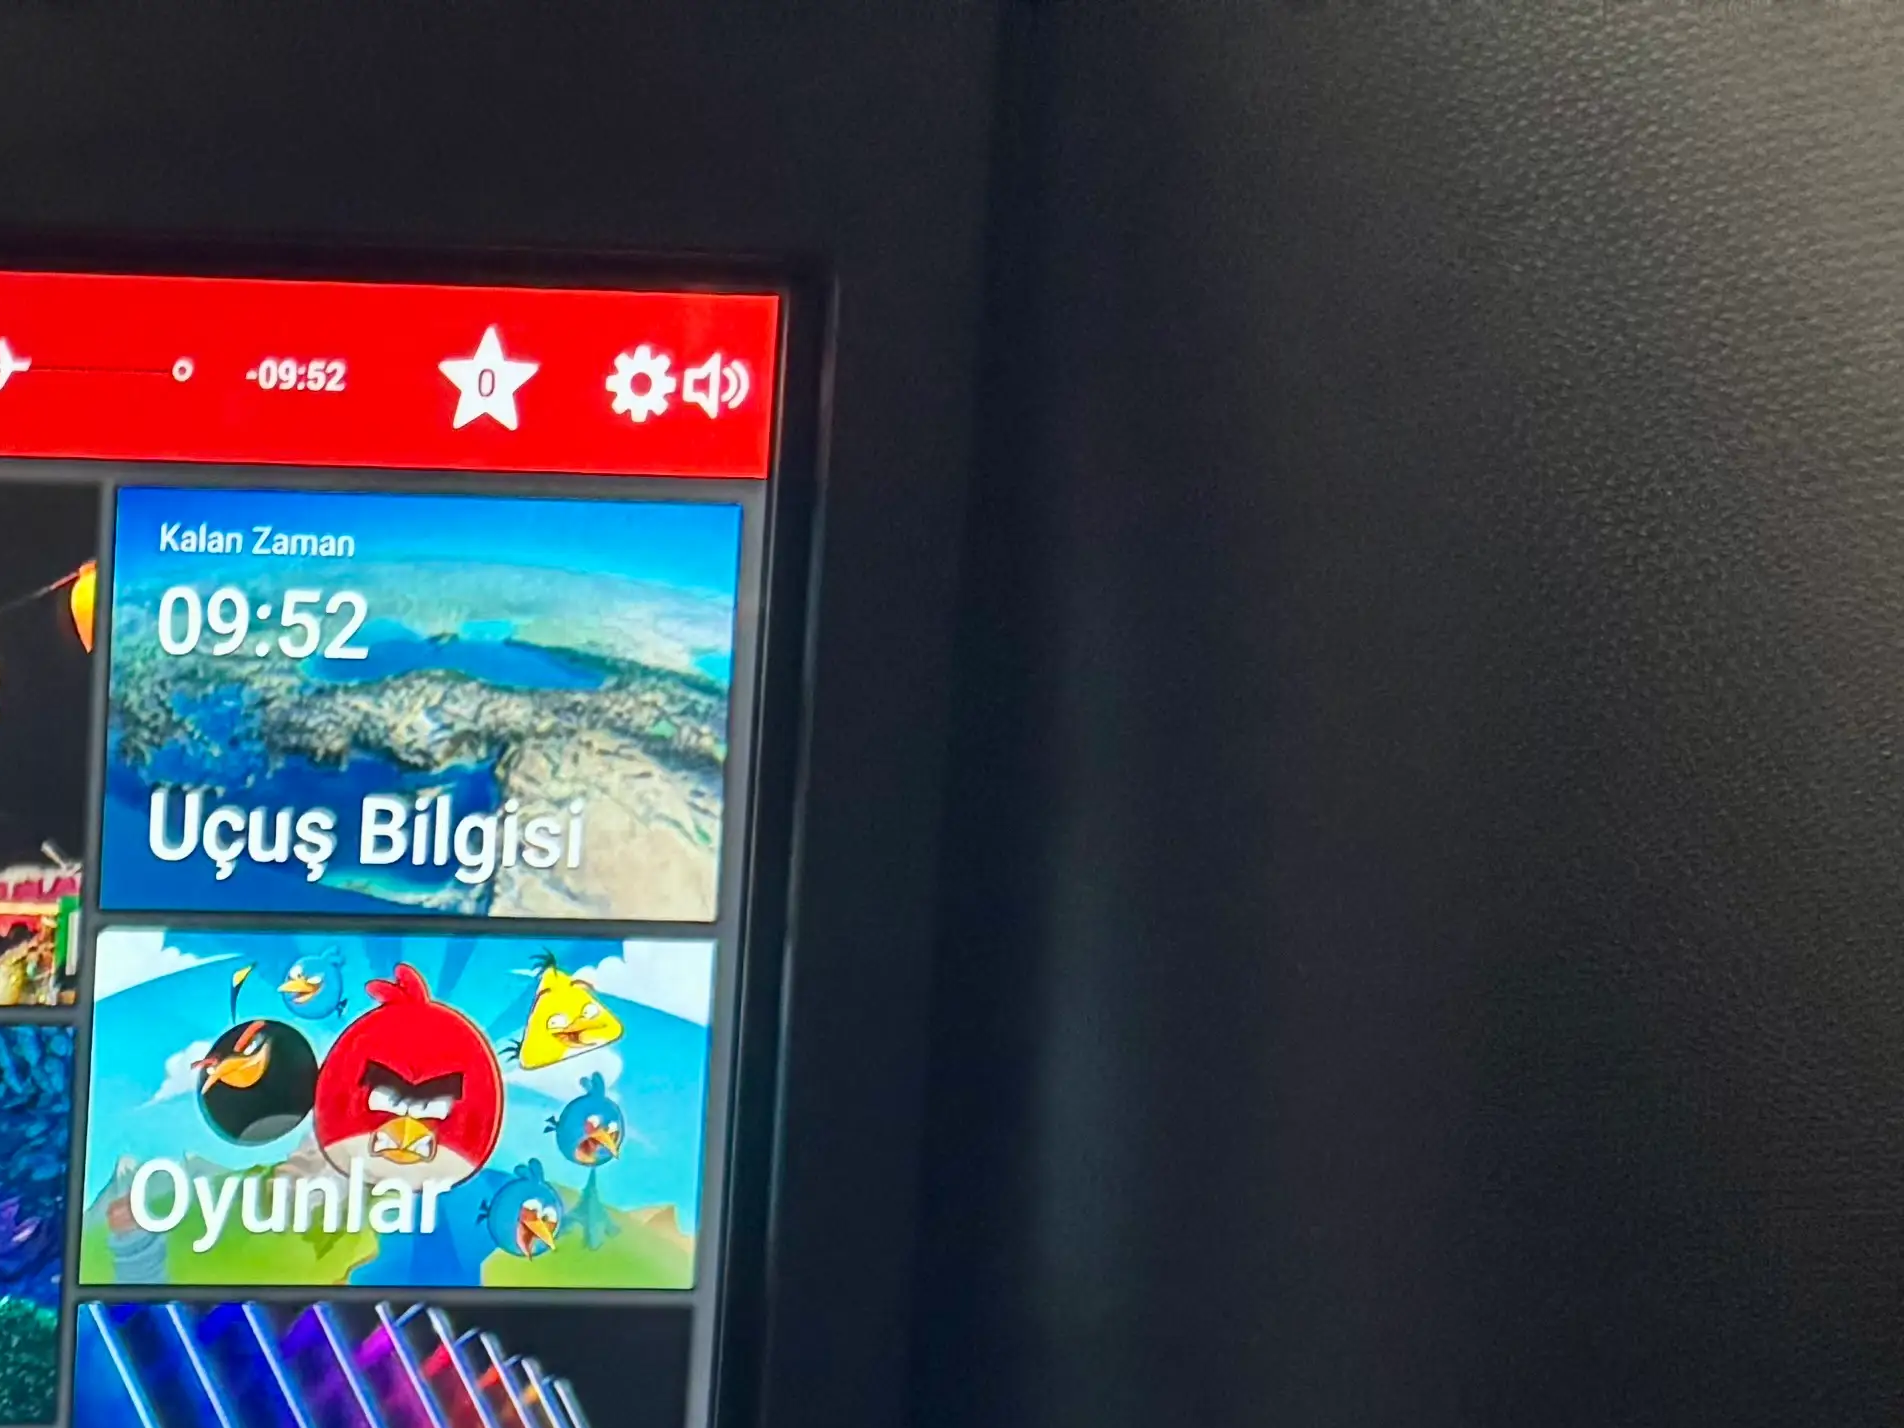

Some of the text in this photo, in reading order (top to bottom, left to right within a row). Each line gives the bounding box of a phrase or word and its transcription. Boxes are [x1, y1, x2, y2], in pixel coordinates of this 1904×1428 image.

[246, 359, 346, 391] -09:52
[477, 369, 496, 398] 0
[159, 523, 355, 559] Kalan Zaman
[157, 585, 370, 661] 09:52
[148, 790, 584, 884] Uçuş Bilgisi
[128, 1157, 454, 1253] Oyunlar
